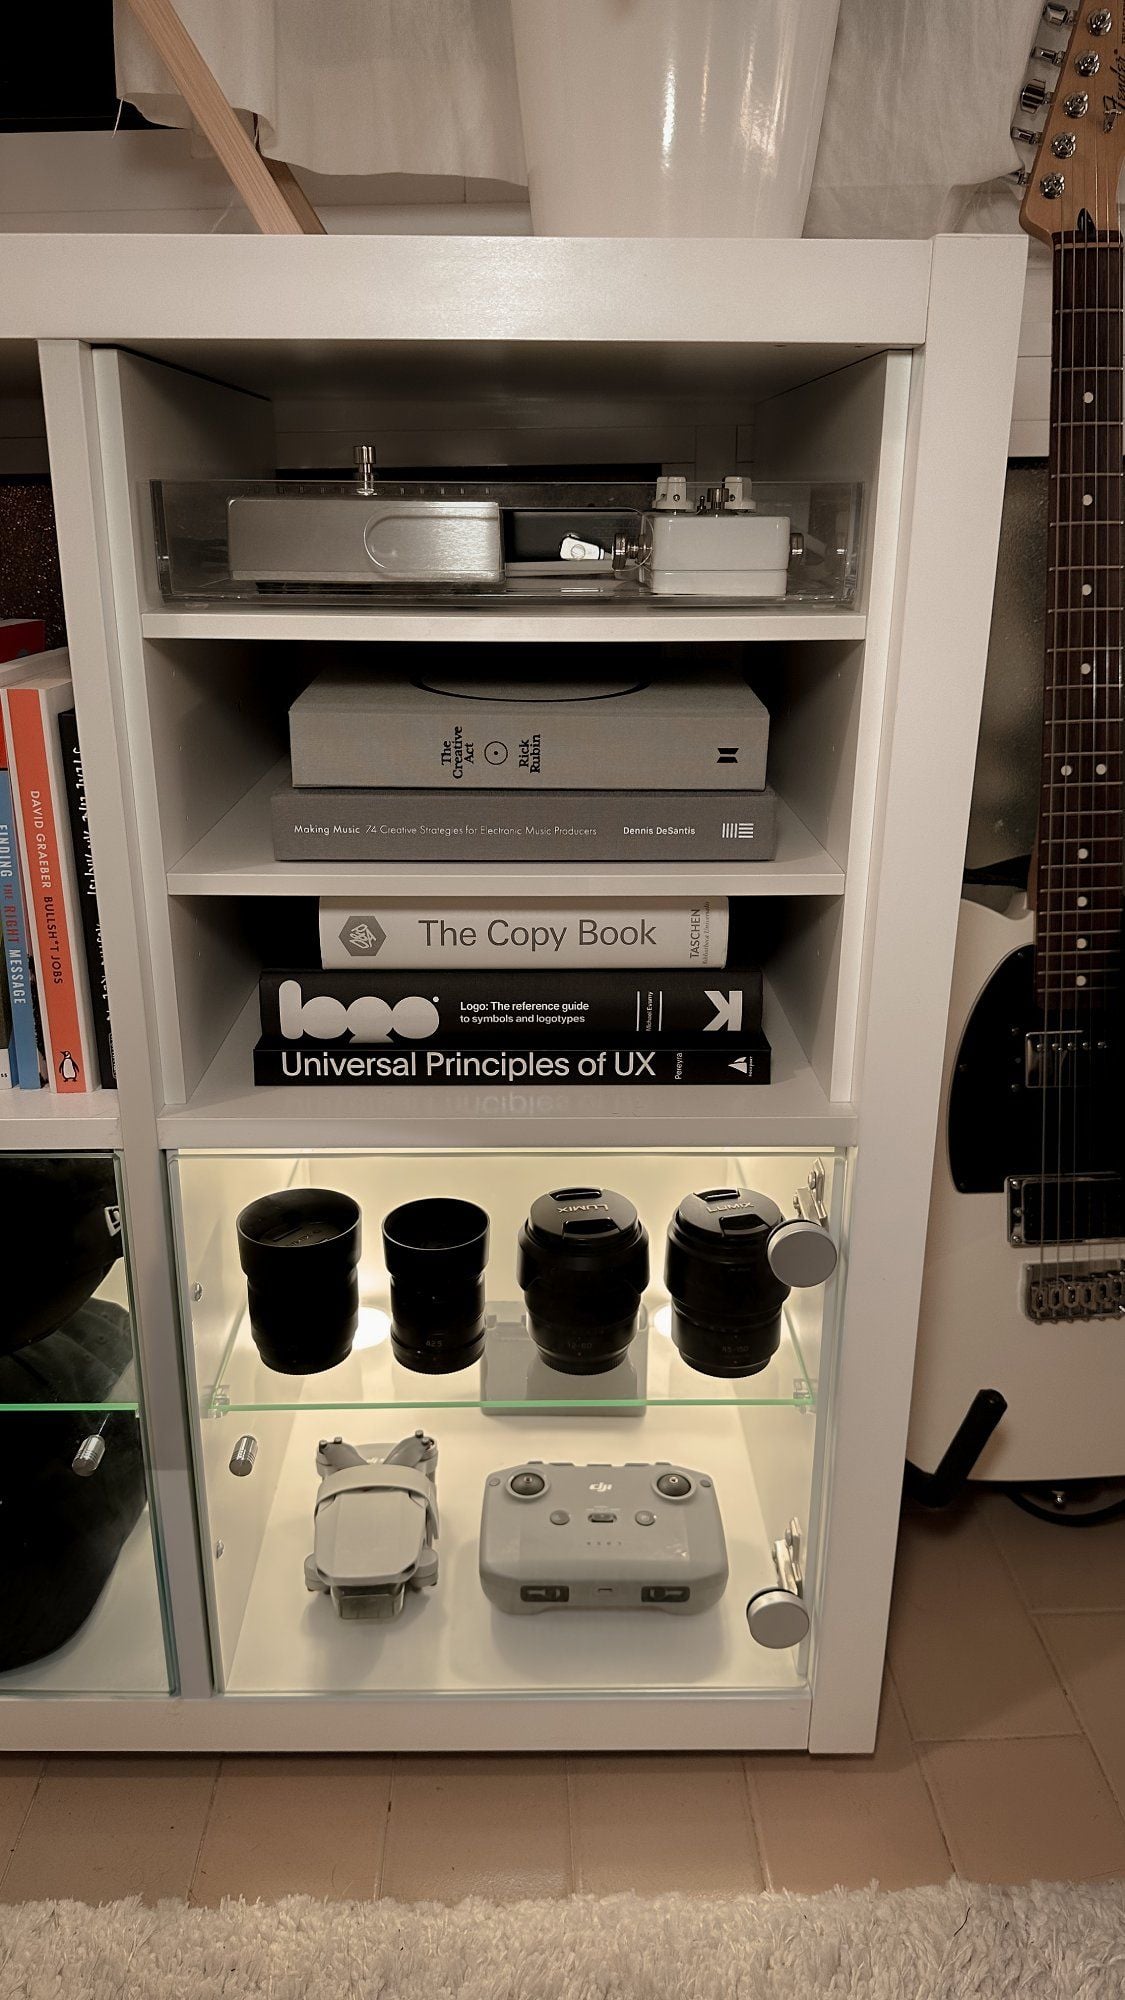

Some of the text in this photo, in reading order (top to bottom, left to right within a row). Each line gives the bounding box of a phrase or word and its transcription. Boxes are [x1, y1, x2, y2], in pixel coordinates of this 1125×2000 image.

[441, 740, 451, 766] The
[452, 725, 463, 779] Creative
[464, 742, 474, 765] Act
[518, 738, 530, 768] Rick
[530, 733, 541, 774] Rubin
[30, 790, 44, 829] DAVID
[294, 824, 696, 836] Making Music 74 Creative Strategies for Electronic Music Producers Dennis DeSantis
[35, 833, 52, 889] GRAEBER
[0, 824, 26, 1005] FINDING THE RIGHT MESSAGE
[418, 918, 657, 952] The Copy Book
[689, 908, 701, 959] TASCHEN
[50, 955, 63, 985] JOBS
[460, 1001, 589, 1013] Logo: The reference guide
[460, 1014, 586, 1025] to symbols and logotypes
[282, 1051, 656, 1082] Universal Principles of UX
[674, 1052, 684, 1080] Pereyra
[557, 1203, 609, 1214] LUMIX
[705, 1201, 755, 1213] LUMIX
